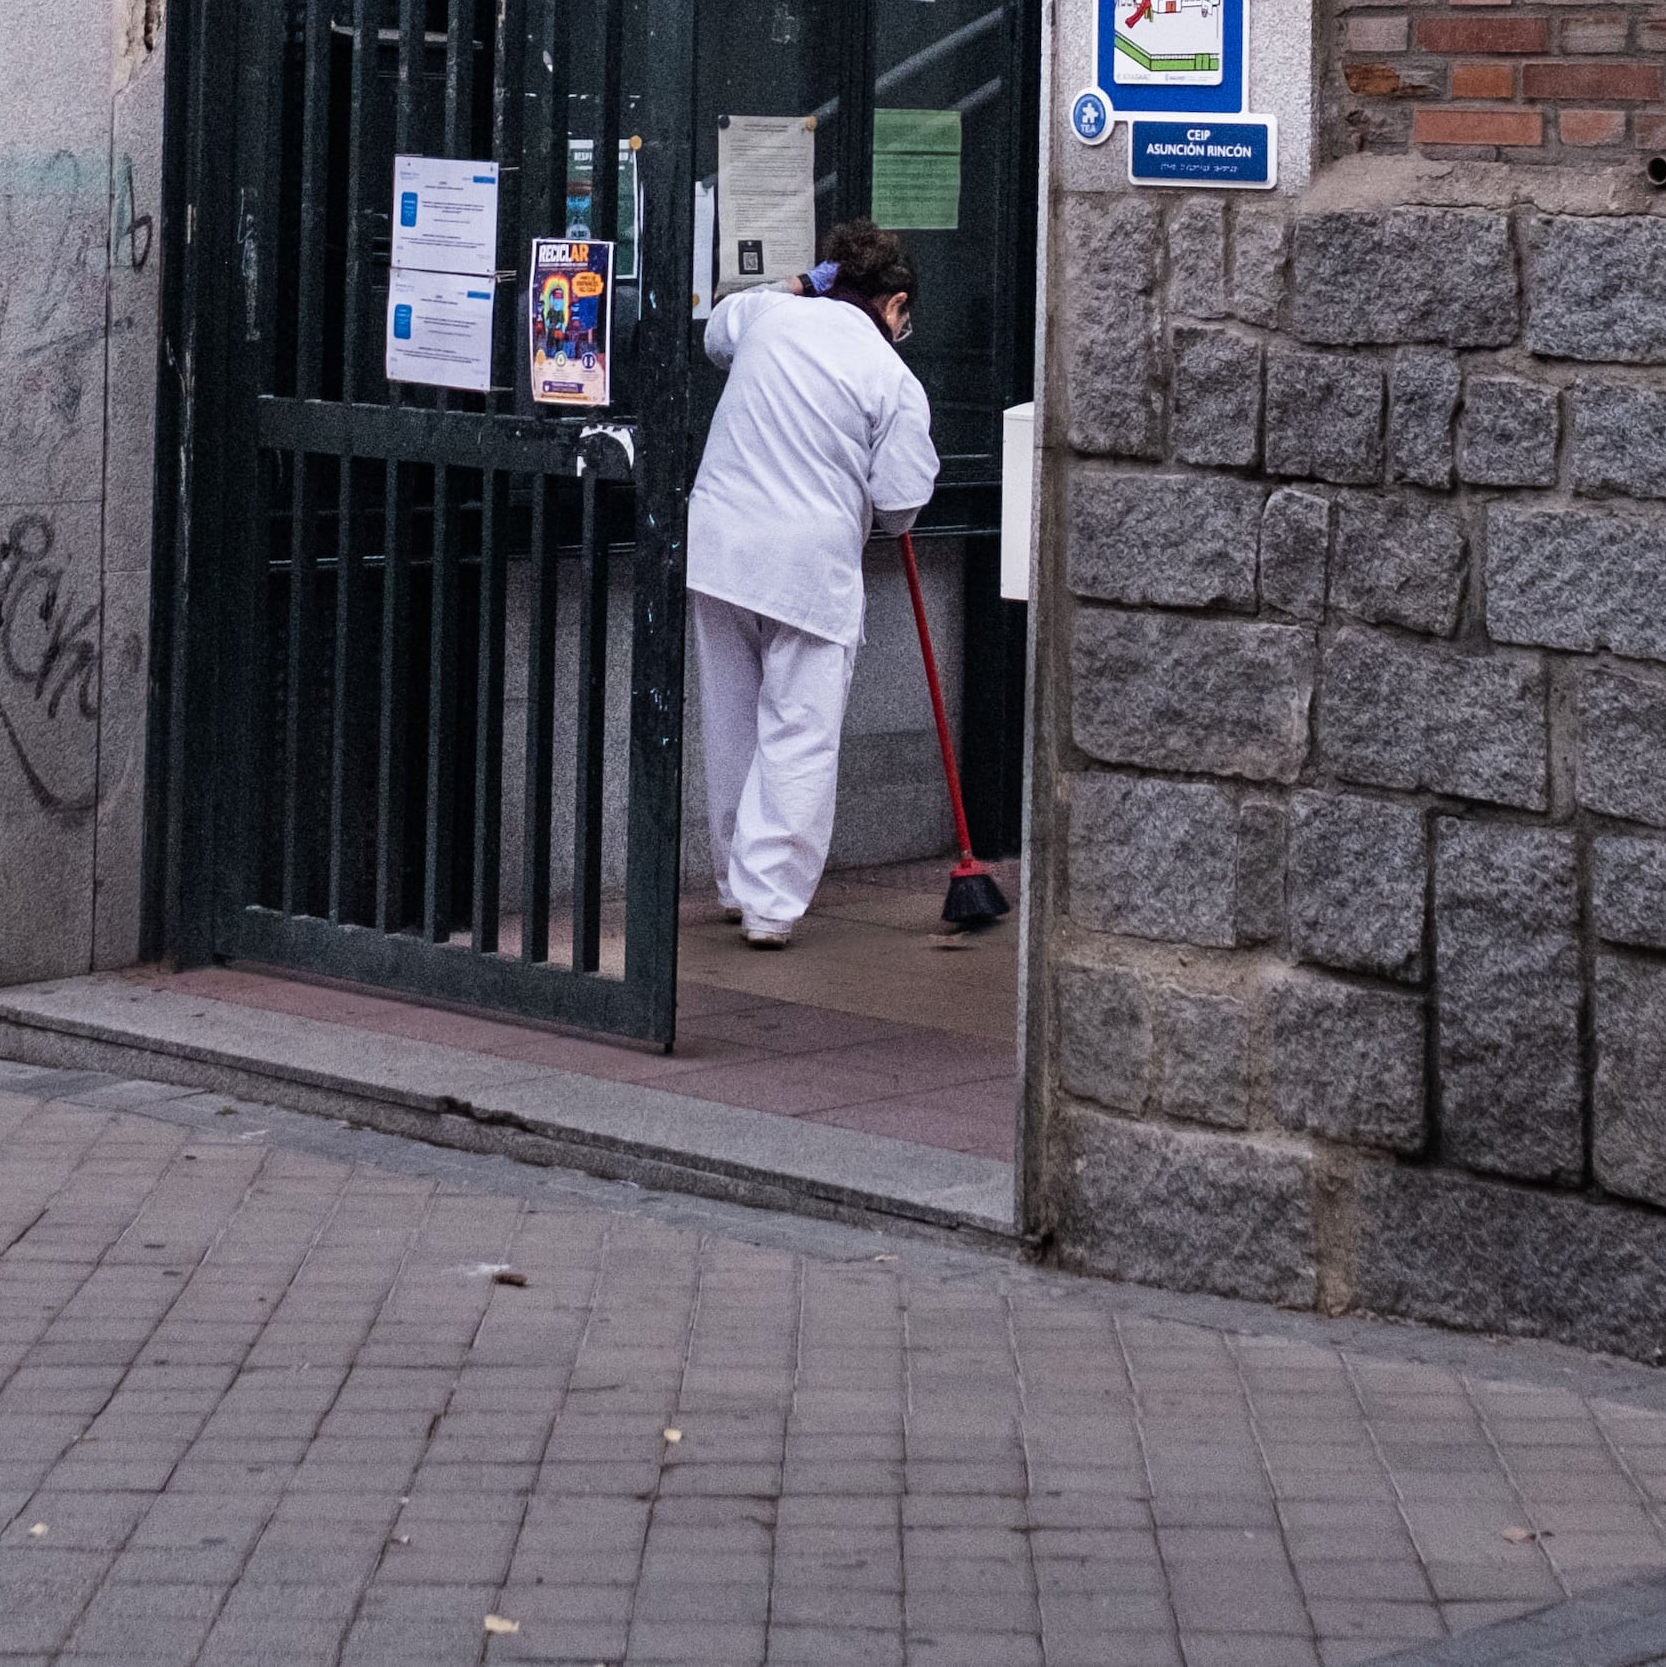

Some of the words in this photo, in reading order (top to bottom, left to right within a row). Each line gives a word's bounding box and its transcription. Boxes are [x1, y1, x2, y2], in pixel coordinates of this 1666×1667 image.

[1081, 124, 1096, 134] TEA
[1186, 129, 1211, 141] CEIP
[1146, 141, 1205, 157] ASUNCIÓN
[1207, 142, 1252, 159] RINCÓN
[539, 243, 589, 263] RECICLAR
